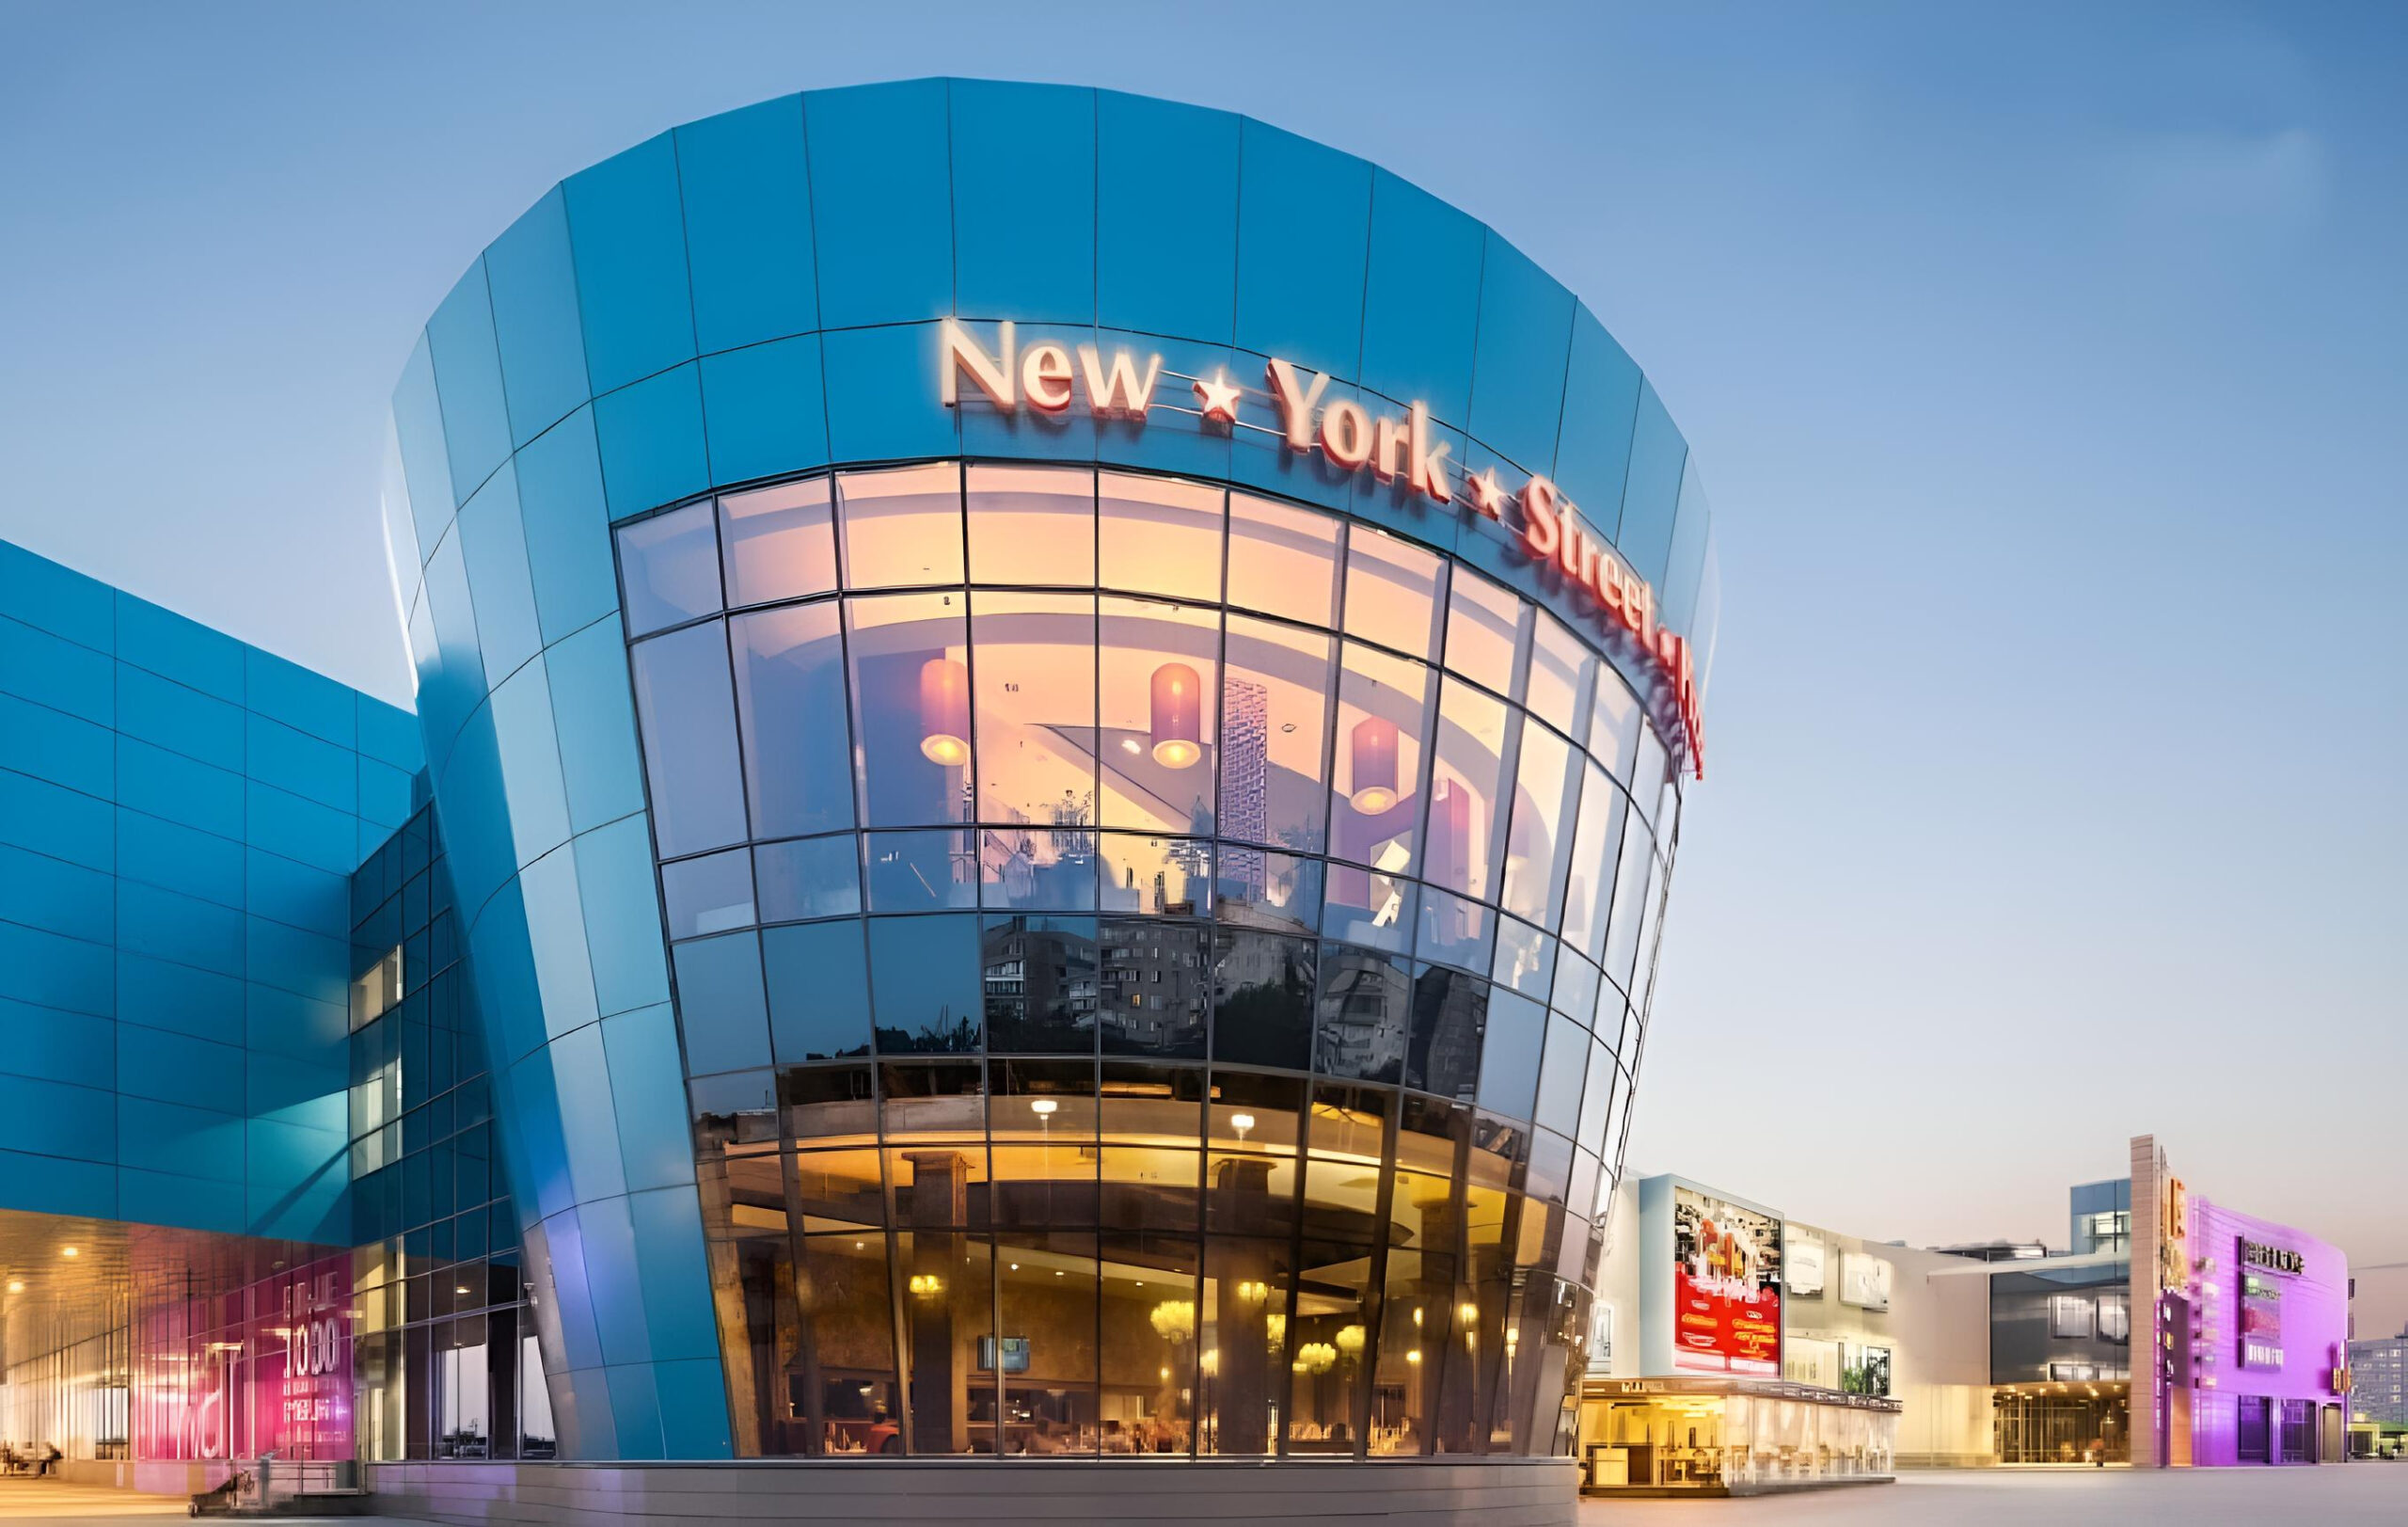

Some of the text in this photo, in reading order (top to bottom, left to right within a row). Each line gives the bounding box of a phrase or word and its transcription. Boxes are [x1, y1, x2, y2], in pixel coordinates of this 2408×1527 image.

[941, 316, 1658, 657] New York Street
